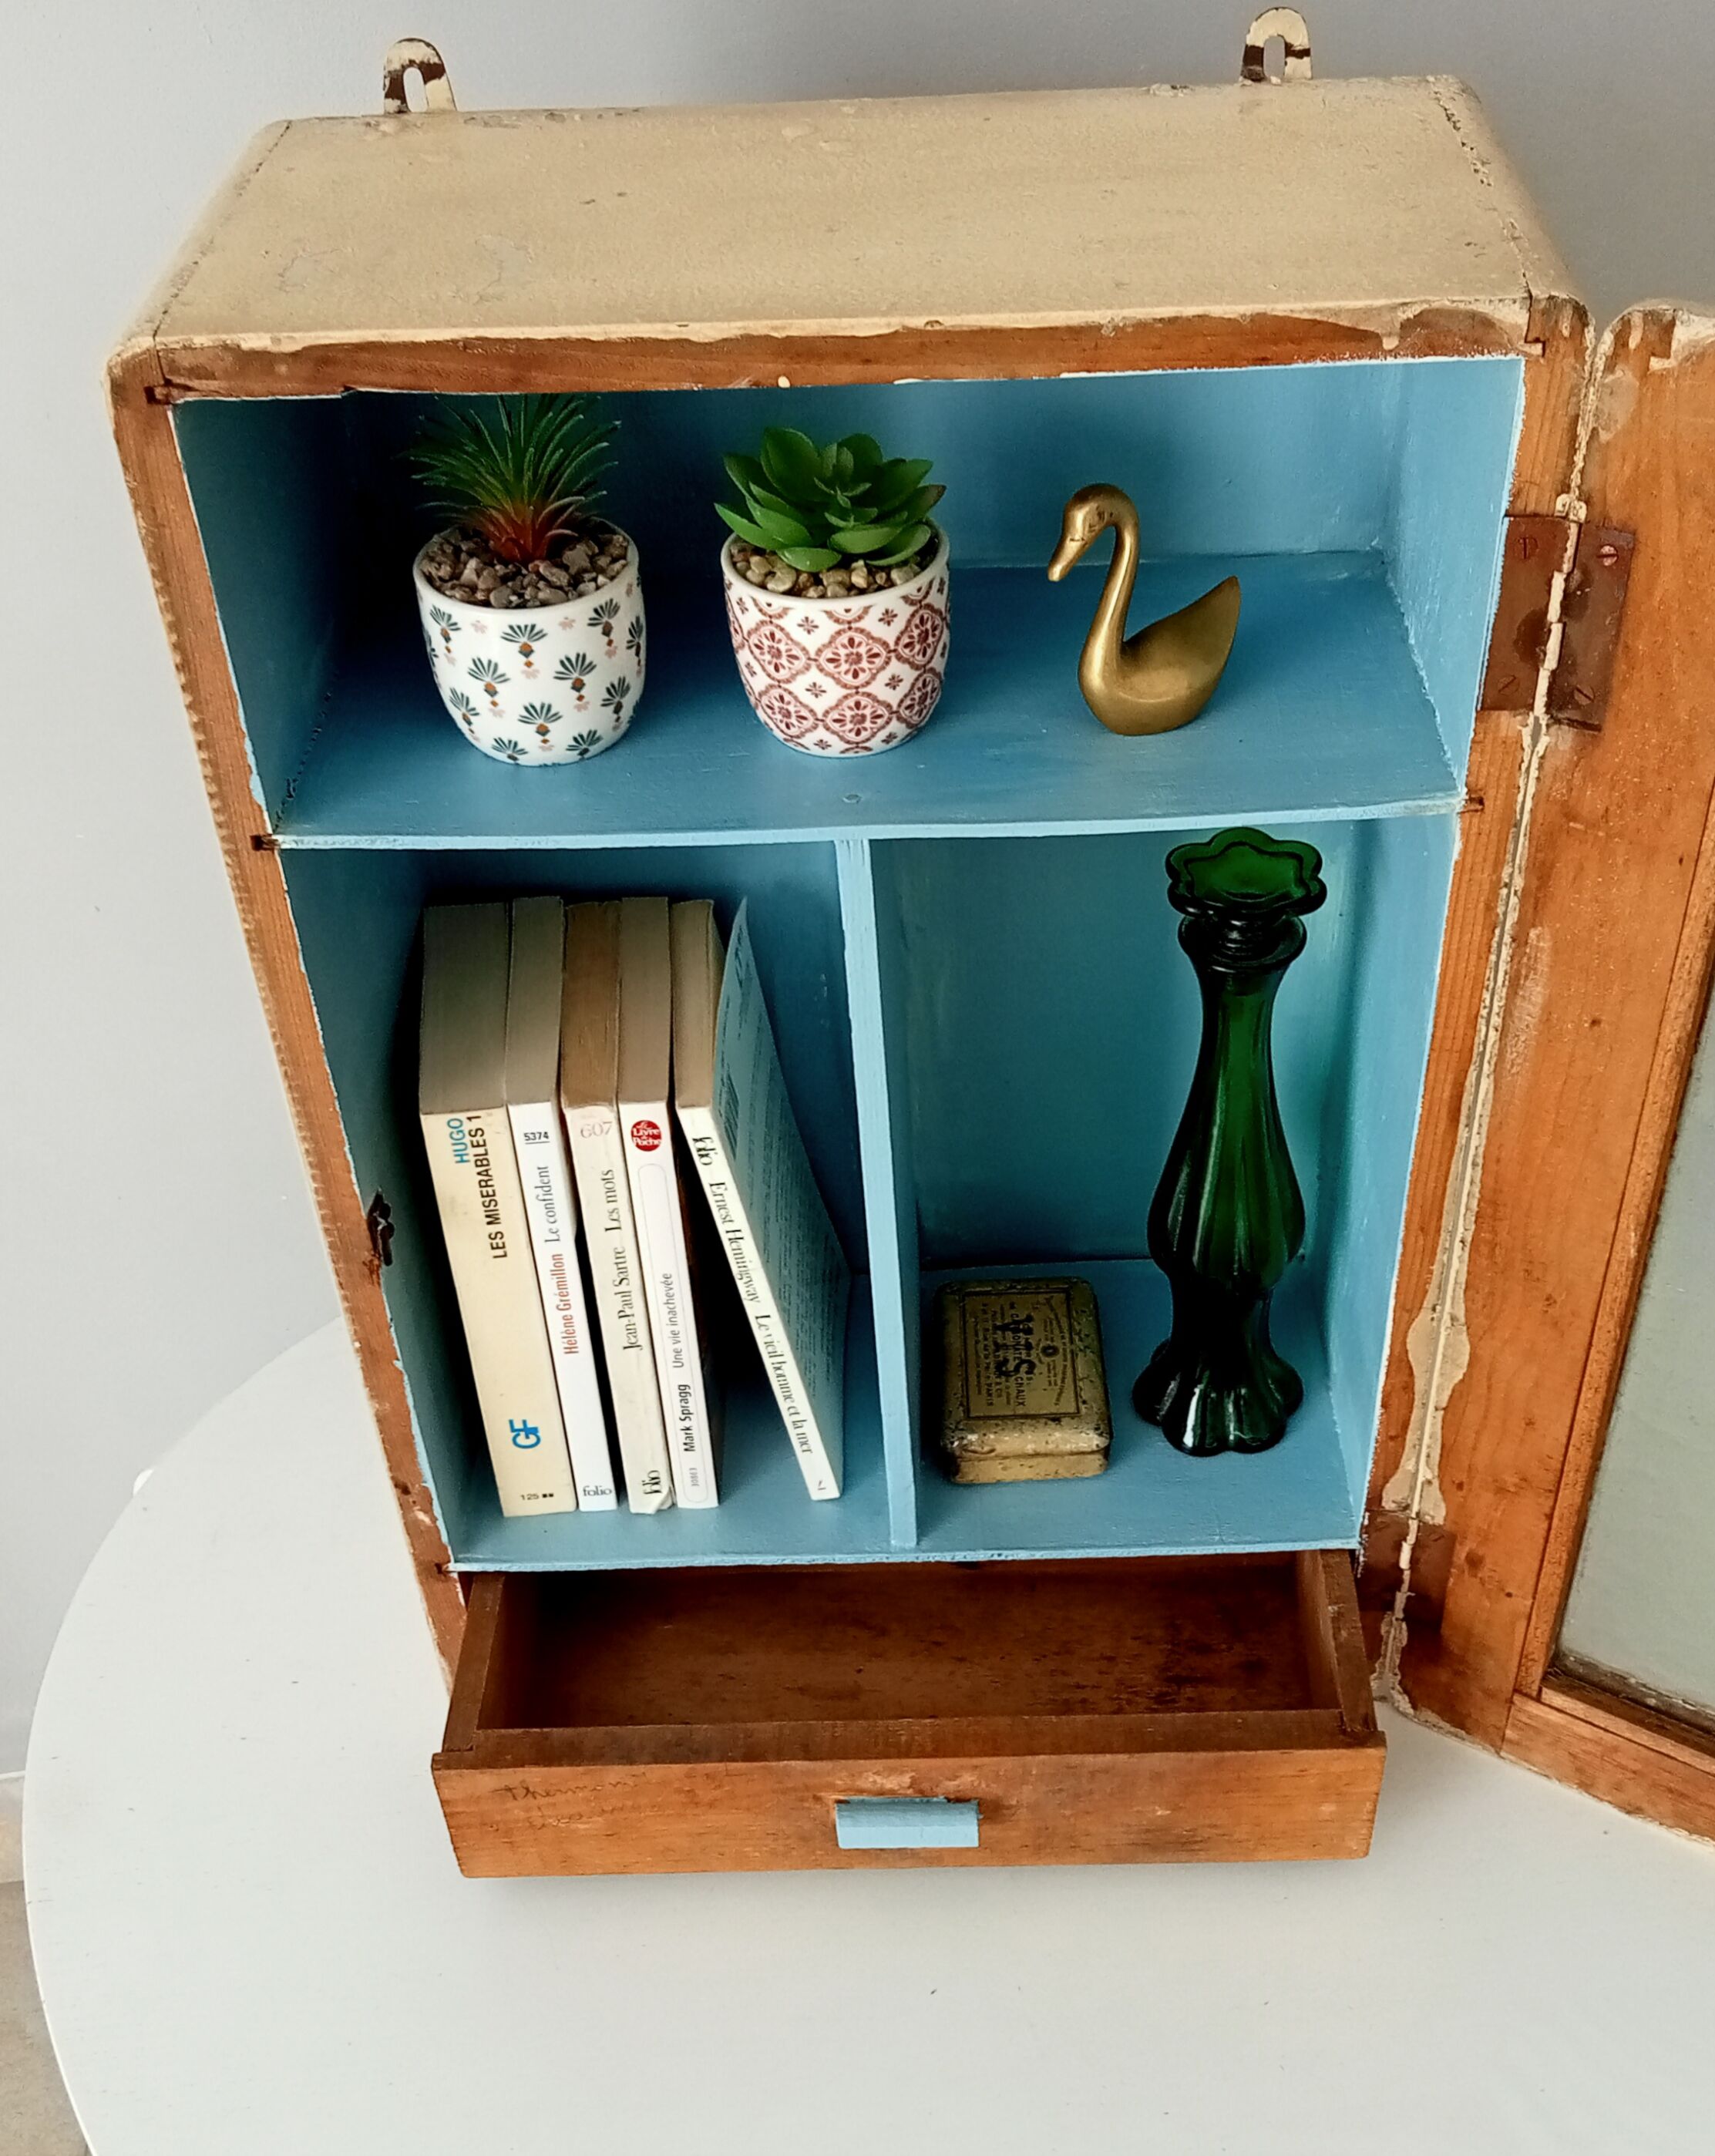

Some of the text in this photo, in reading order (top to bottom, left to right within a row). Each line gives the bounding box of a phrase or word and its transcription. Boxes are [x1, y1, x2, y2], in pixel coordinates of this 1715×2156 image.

[447, 1118, 470, 1164] HUGO
[523, 1132, 550, 1141] 5374
[580, 1121, 612, 1139] 607
[633, 1128, 661, 1136] Livre
[692, 1136, 718, 1166] folio
[469, 1128, 502, 1226] MISERABLES
[708, 1182, 735, 1224] Ernest
[489, 1231, 507, 1259] LES
[601, 1169, 643, 1350] Jean-Paul Sartre Les mots
[534, 1166, 579, 1354] Hélène Grémillon Le confident
[725, 1229, 761, 1303] Hemingway
[755, 1314, 772, 1331] Le
[661, 1273, 696, 1452] Mark Spragg Une vie inachevée
[771, 1361, 795, 1404] homme
[787, 1405, 801, 1417] et
[791, 1418, 808, 1430] la
[508, 1419, 541, 1448] GF
[795, 1432, 814, 1454] mer
[583, 1485, 613, 1497] folio
